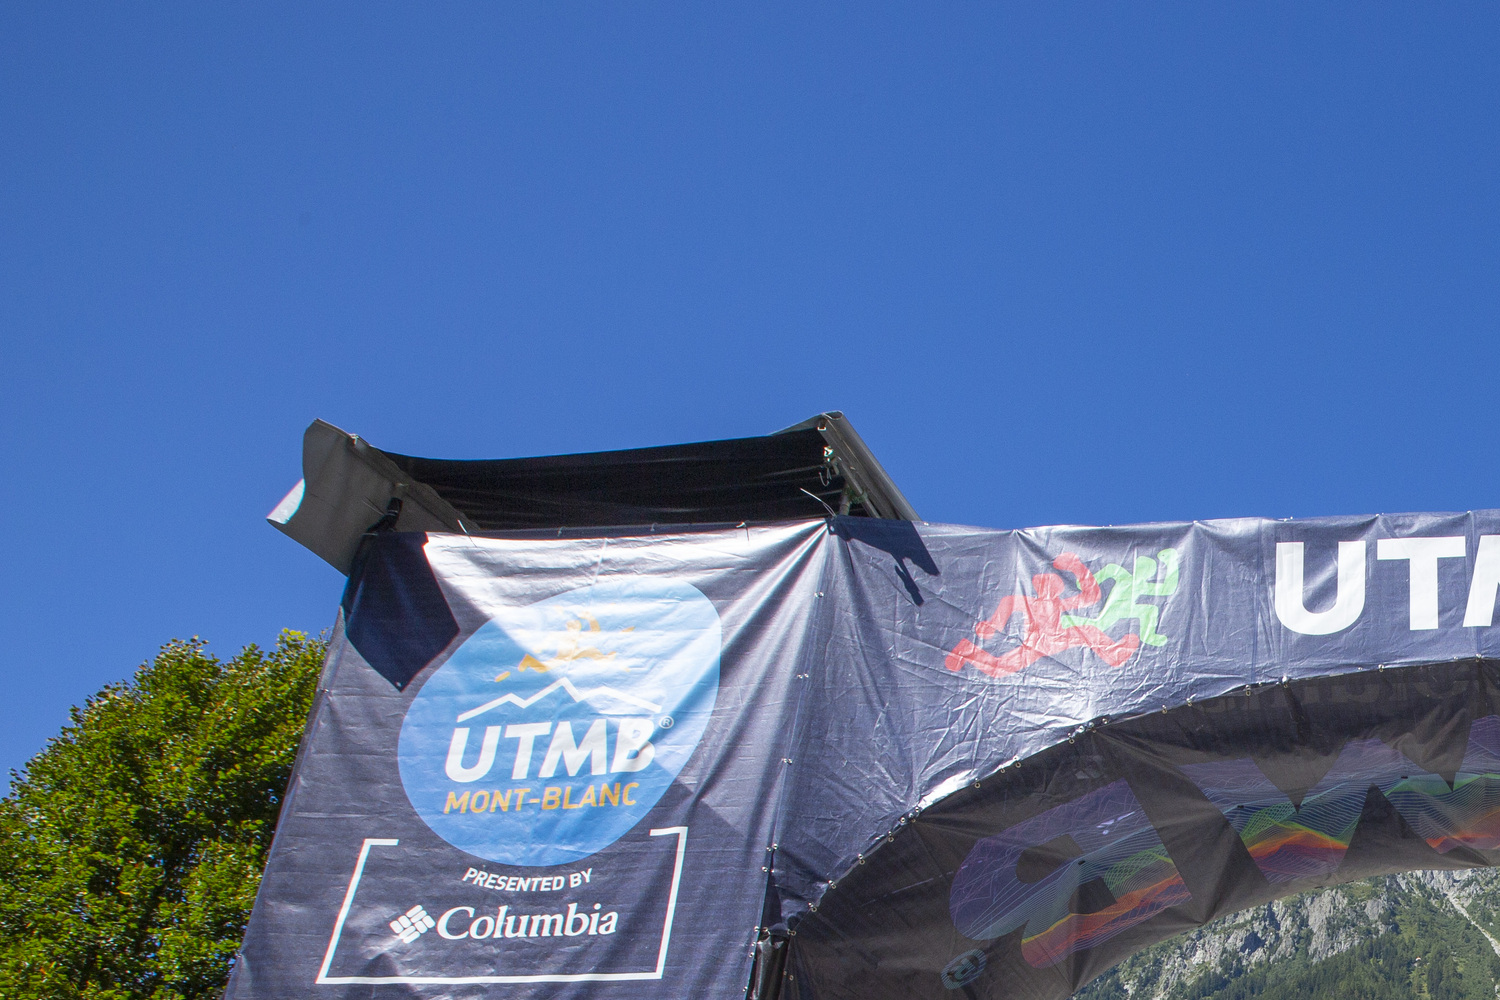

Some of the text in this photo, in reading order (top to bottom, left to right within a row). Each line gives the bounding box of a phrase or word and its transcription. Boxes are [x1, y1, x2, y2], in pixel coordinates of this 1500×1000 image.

[443, 782, 640, 815] MONT-BLANC
[462, 867, 593, 892] PRESENTED BY
[437, 904, 619, 940] Columbia
